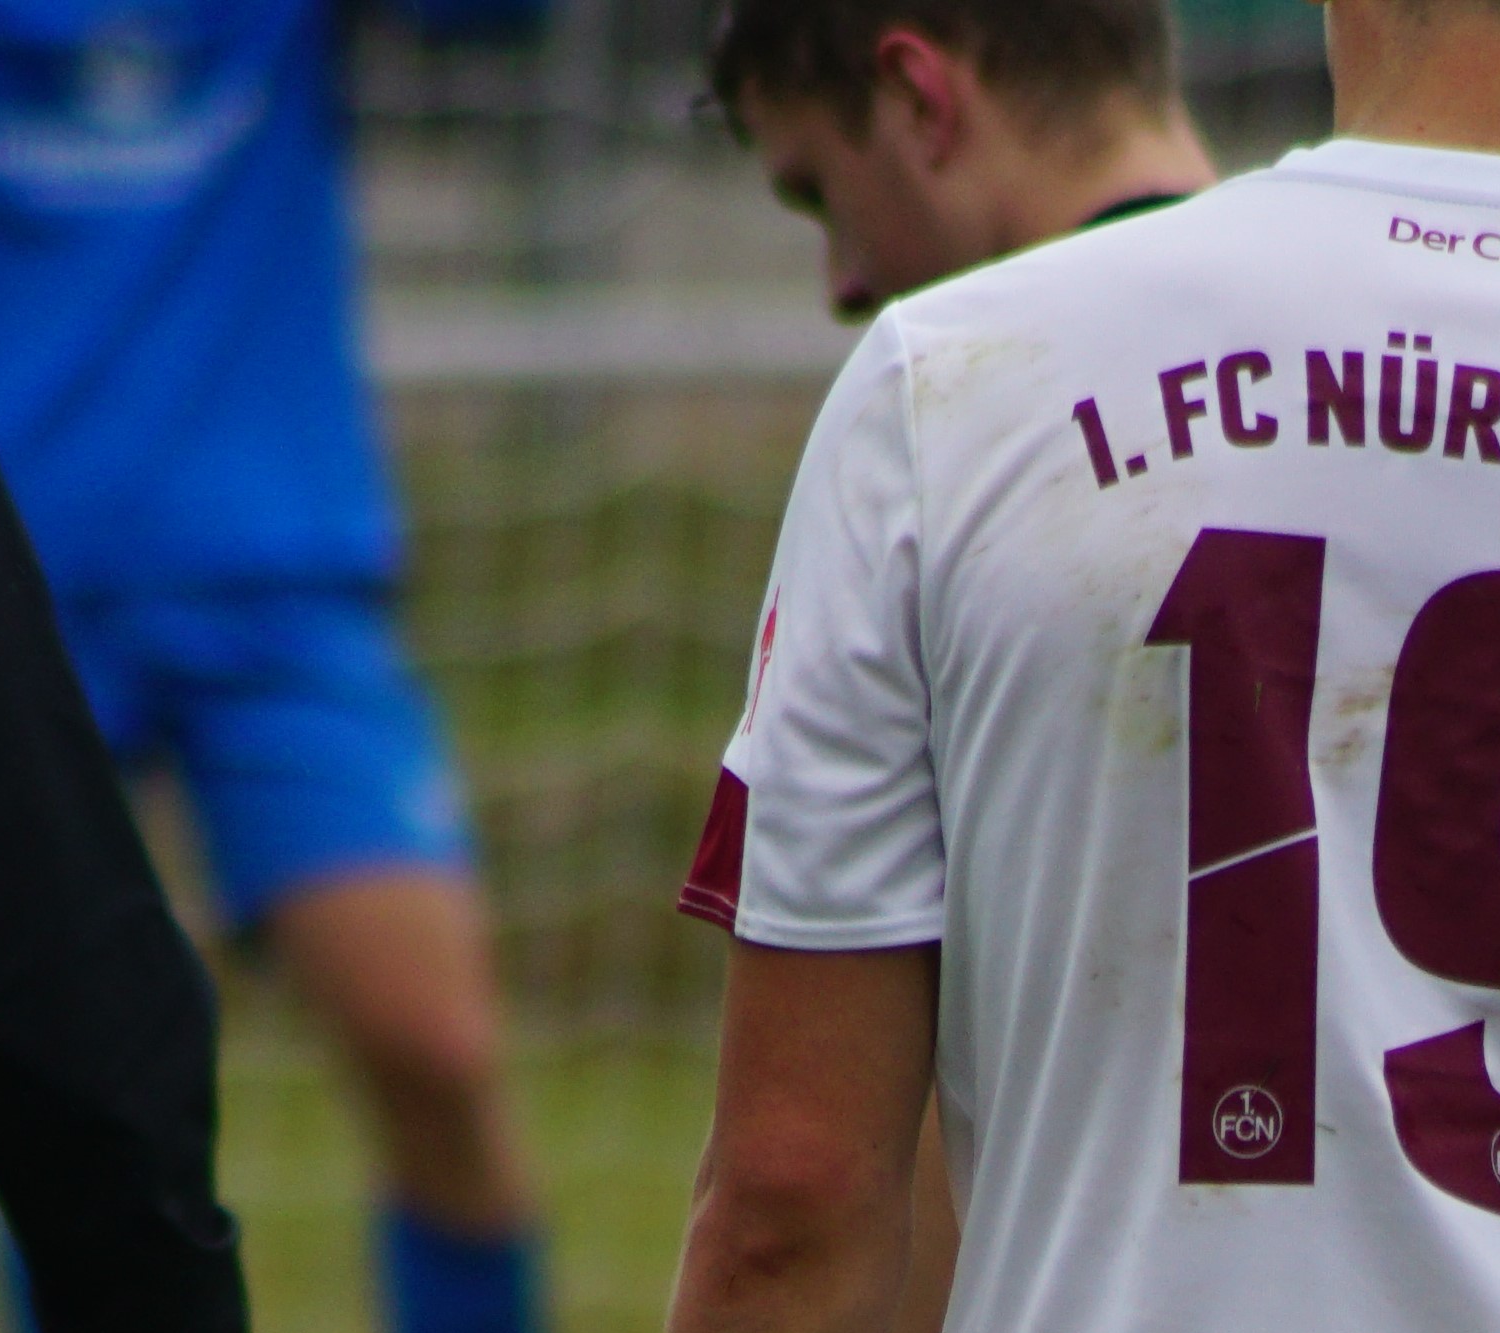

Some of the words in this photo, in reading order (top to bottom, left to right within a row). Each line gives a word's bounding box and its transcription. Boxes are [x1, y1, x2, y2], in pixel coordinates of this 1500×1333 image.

[1388, 216, 1465, 254] Der
[1071, 396, 1148, 490] 1.
[1158, 351, 1279, 461] FC
[1220, 1115, 1275, 1141] FCN
